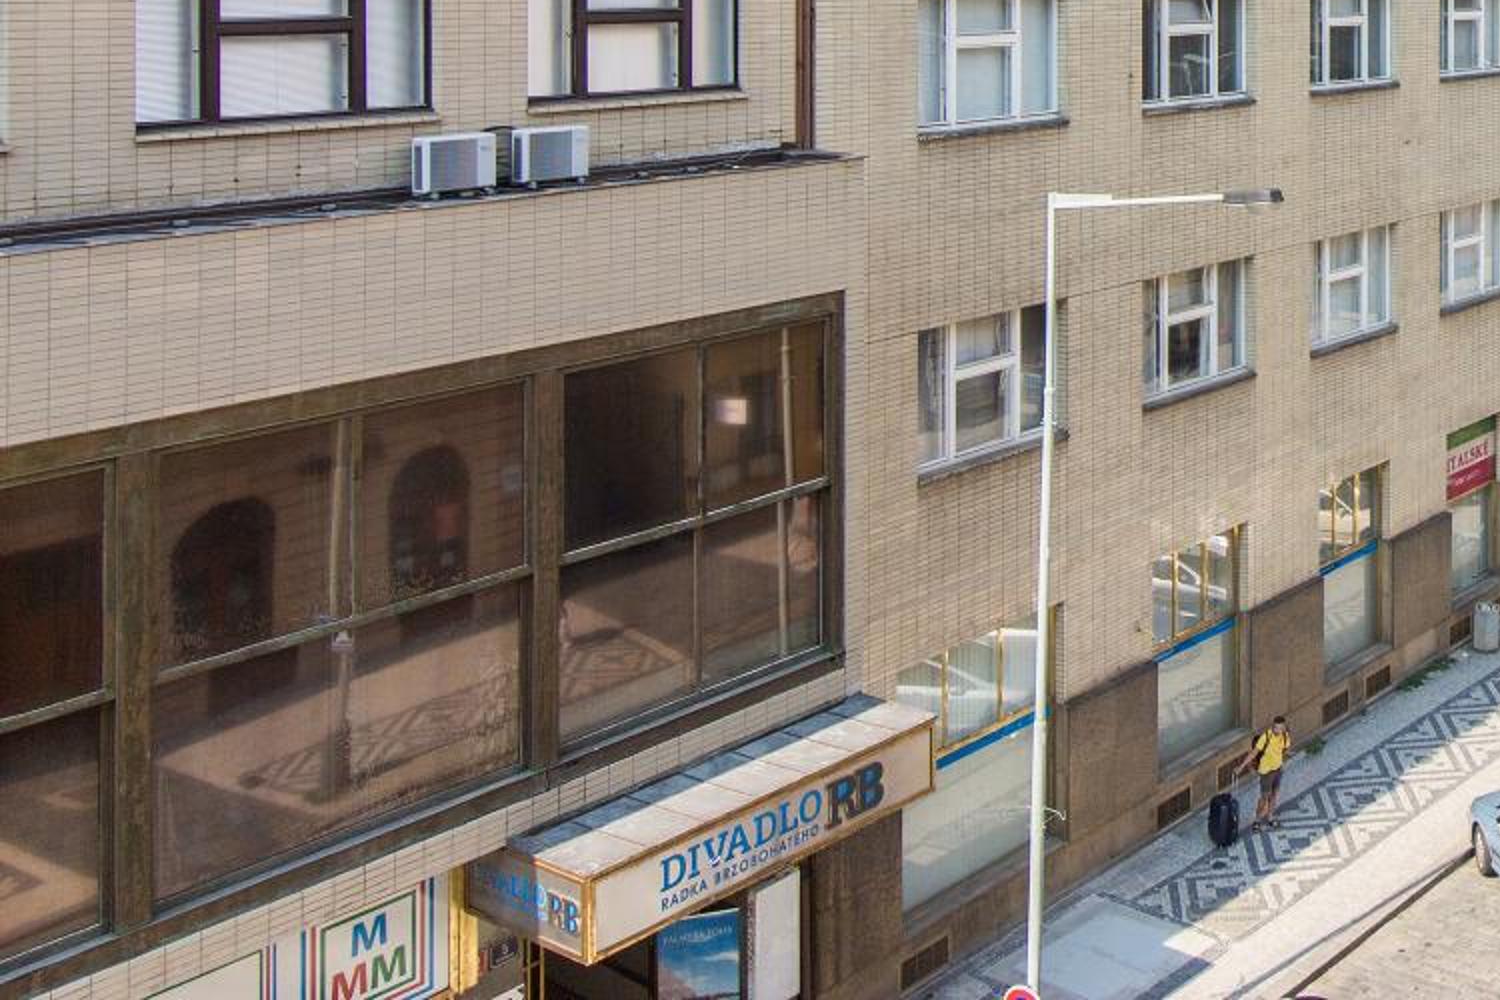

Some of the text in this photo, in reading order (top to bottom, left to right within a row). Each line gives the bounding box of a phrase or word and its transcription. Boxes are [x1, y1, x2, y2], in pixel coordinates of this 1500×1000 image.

[659, 760, 885, 892] DIVADLO RB
[547, 890, 579, 936] RB
[660, 879, 708, 912] RADKA
[351, 911, 388, 957] M
